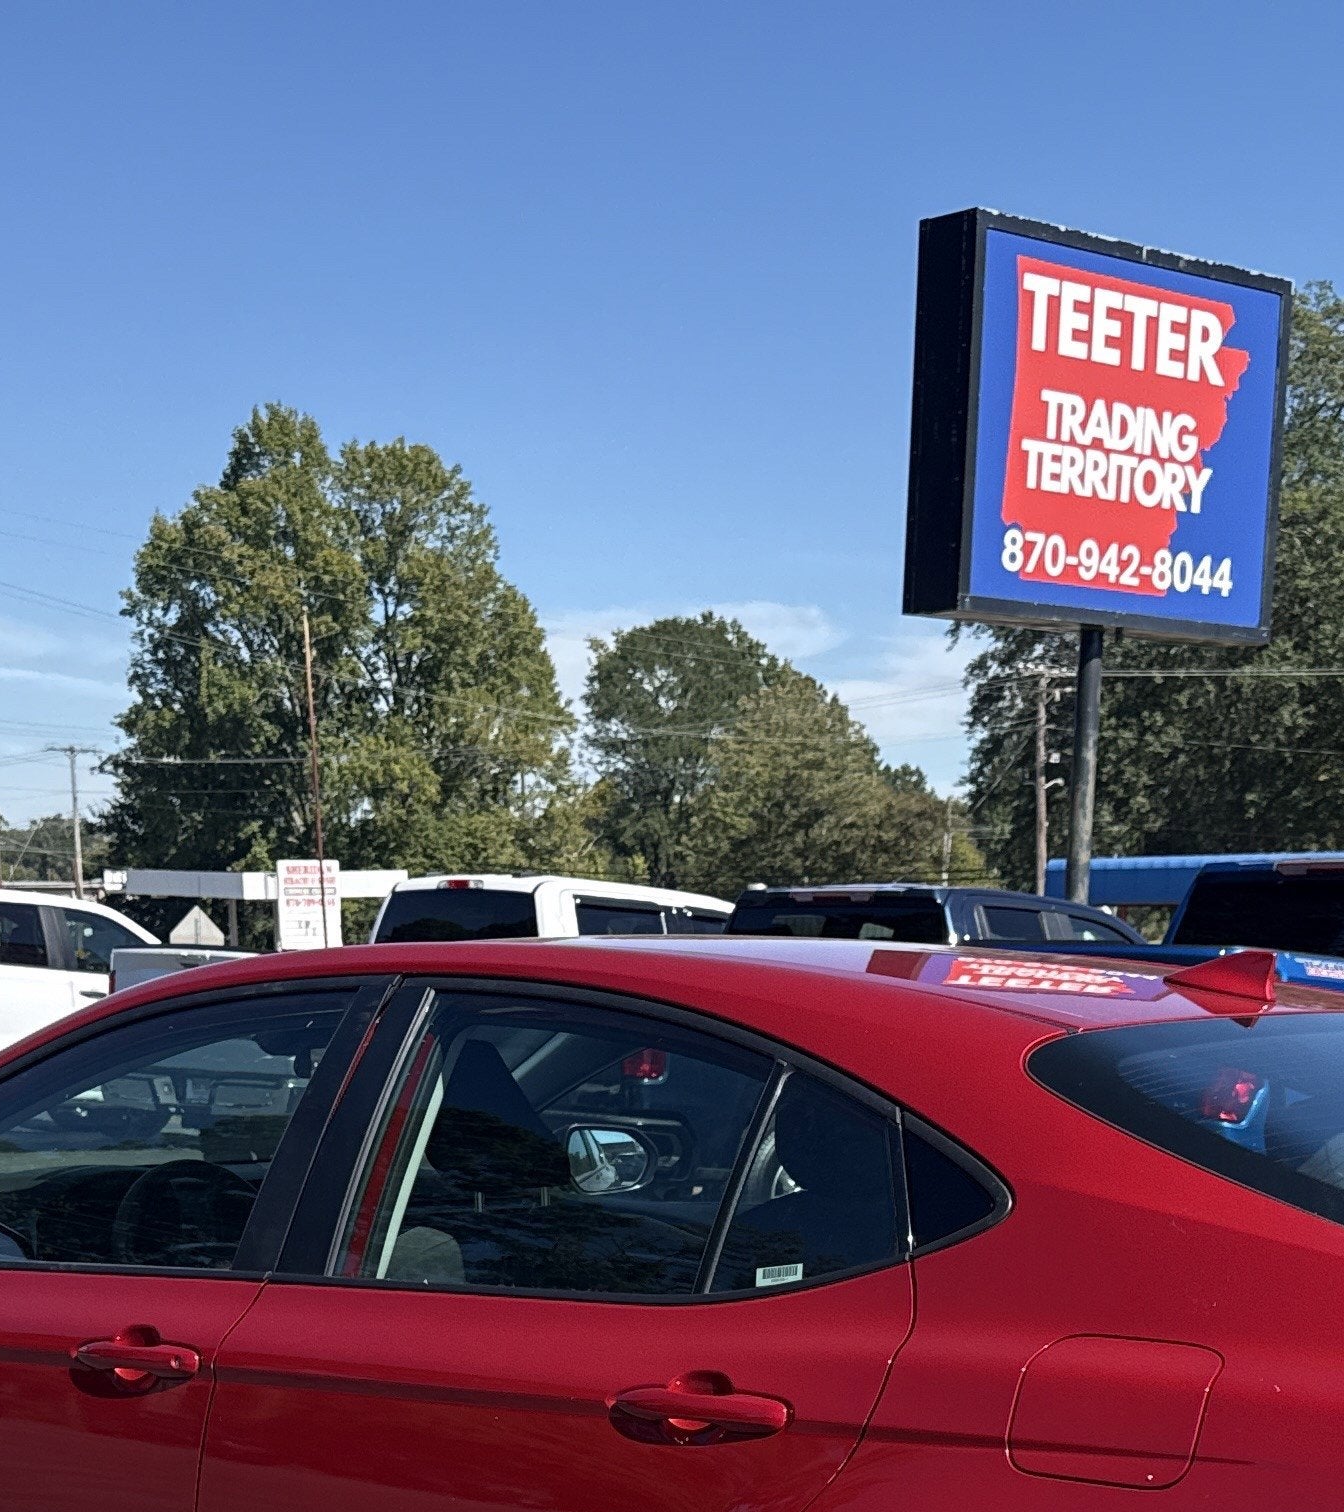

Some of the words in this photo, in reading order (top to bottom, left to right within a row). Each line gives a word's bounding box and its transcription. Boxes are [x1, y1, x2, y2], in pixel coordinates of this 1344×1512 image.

[1022, 272, 1225, 387] TEETER
[1040, 388, 1199, 463] TRADING
[1020, 438, 1213, 514] TERRITORY
[1001, 529, 1233, 598] 870-942-8044
